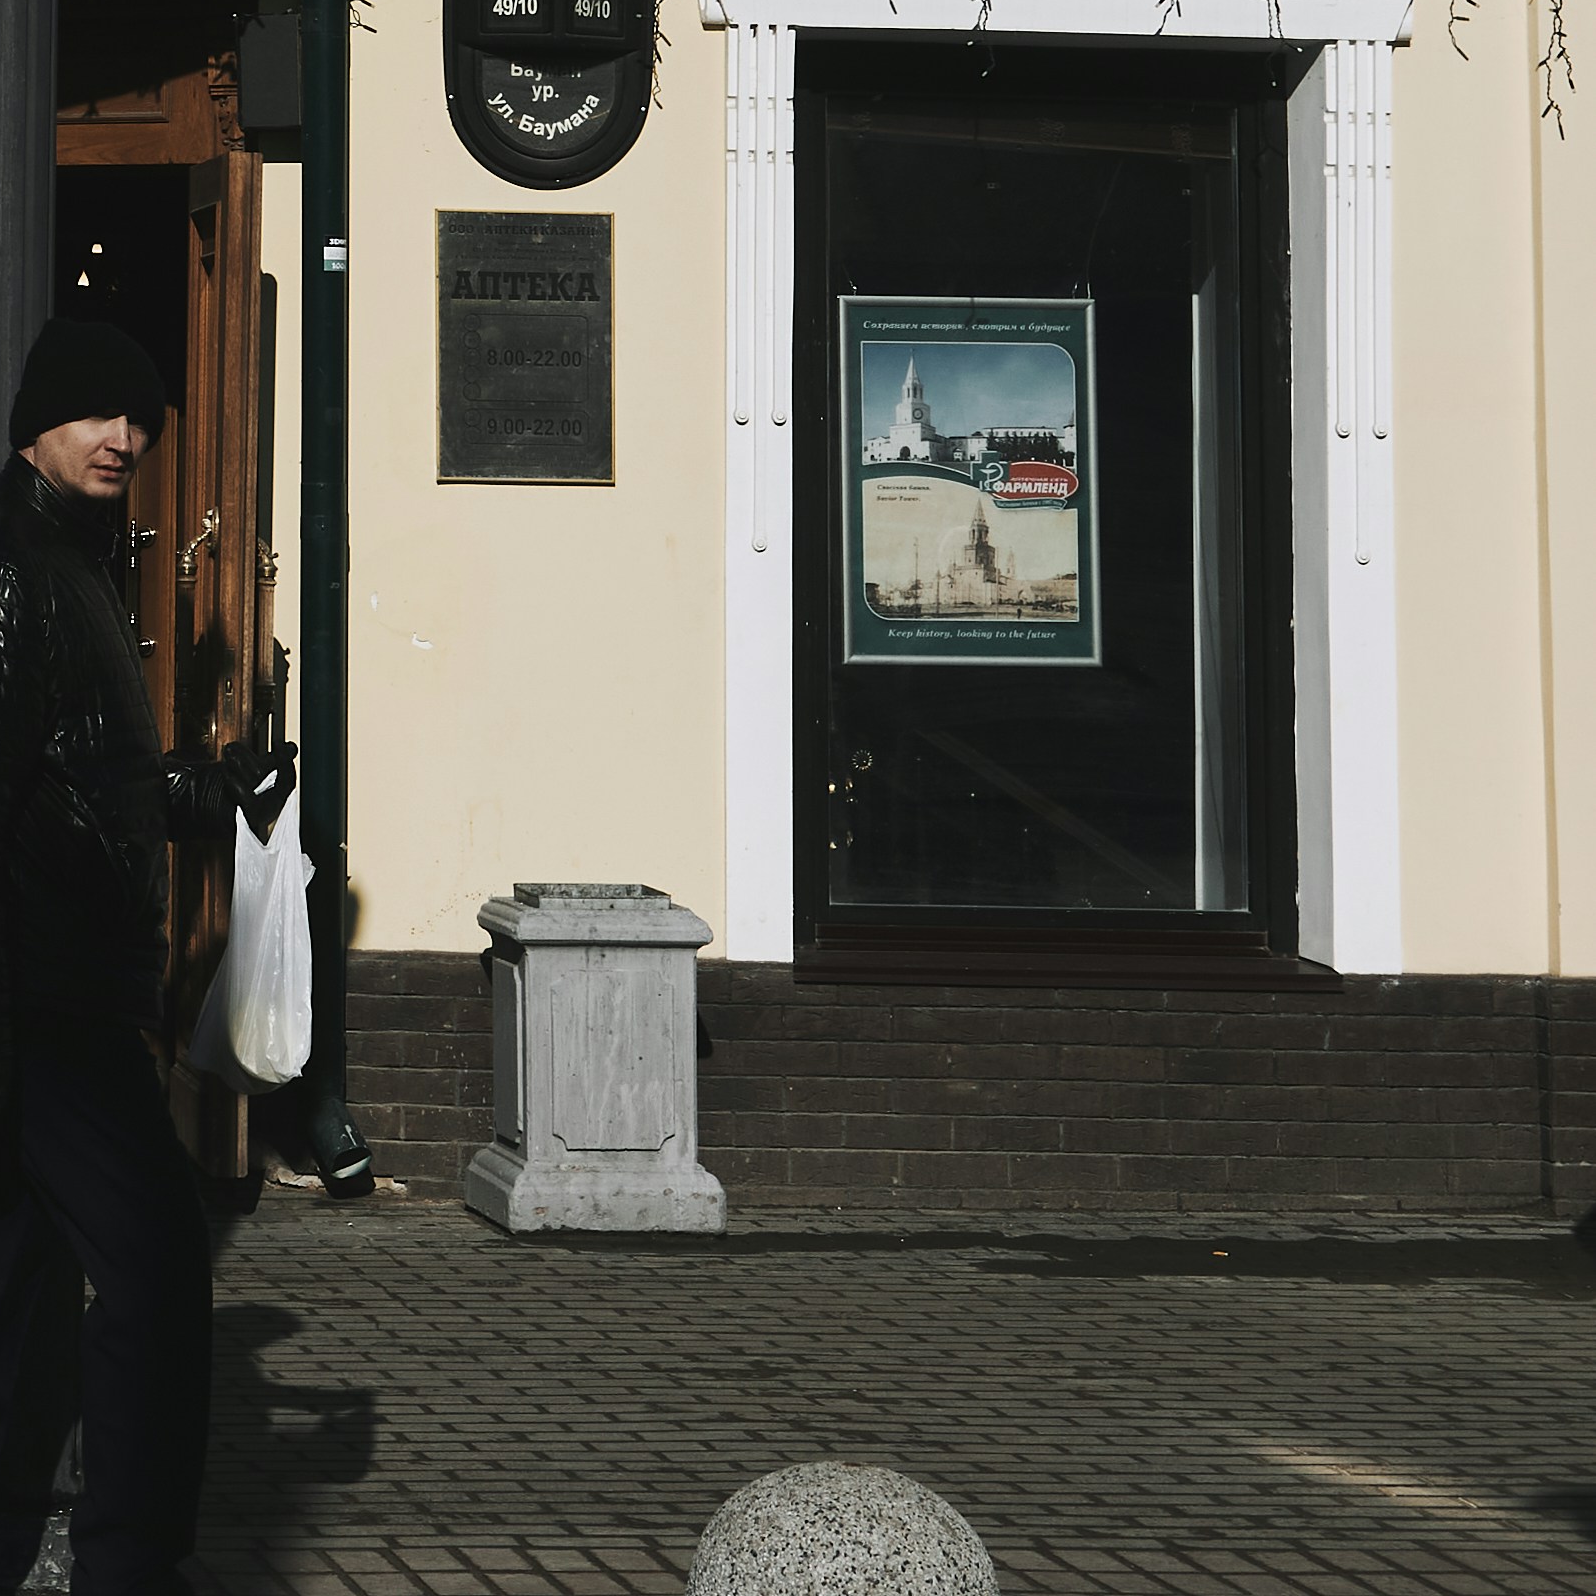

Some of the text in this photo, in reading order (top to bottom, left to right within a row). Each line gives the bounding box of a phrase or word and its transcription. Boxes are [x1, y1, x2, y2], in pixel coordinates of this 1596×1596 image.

[531, 84, 560, 102] ур.
[487, 92, 600, 140] ул. Баумана
[451, 270, 601, 302] АПТЕКА
[863, 320, 918, 332] Сохраняем
[972, 323, 1017, 333] смотрим
[1028, 322, 1071, 333] будущее
[486, 349, 582, 368] 8.00-22.00
[486, 418, 582, 436] 9.00-22.00
[992, 480, 1069, 496] ФАРМЛЕНД
[888, 628, 1057, 640] Keep history, looking to the future
